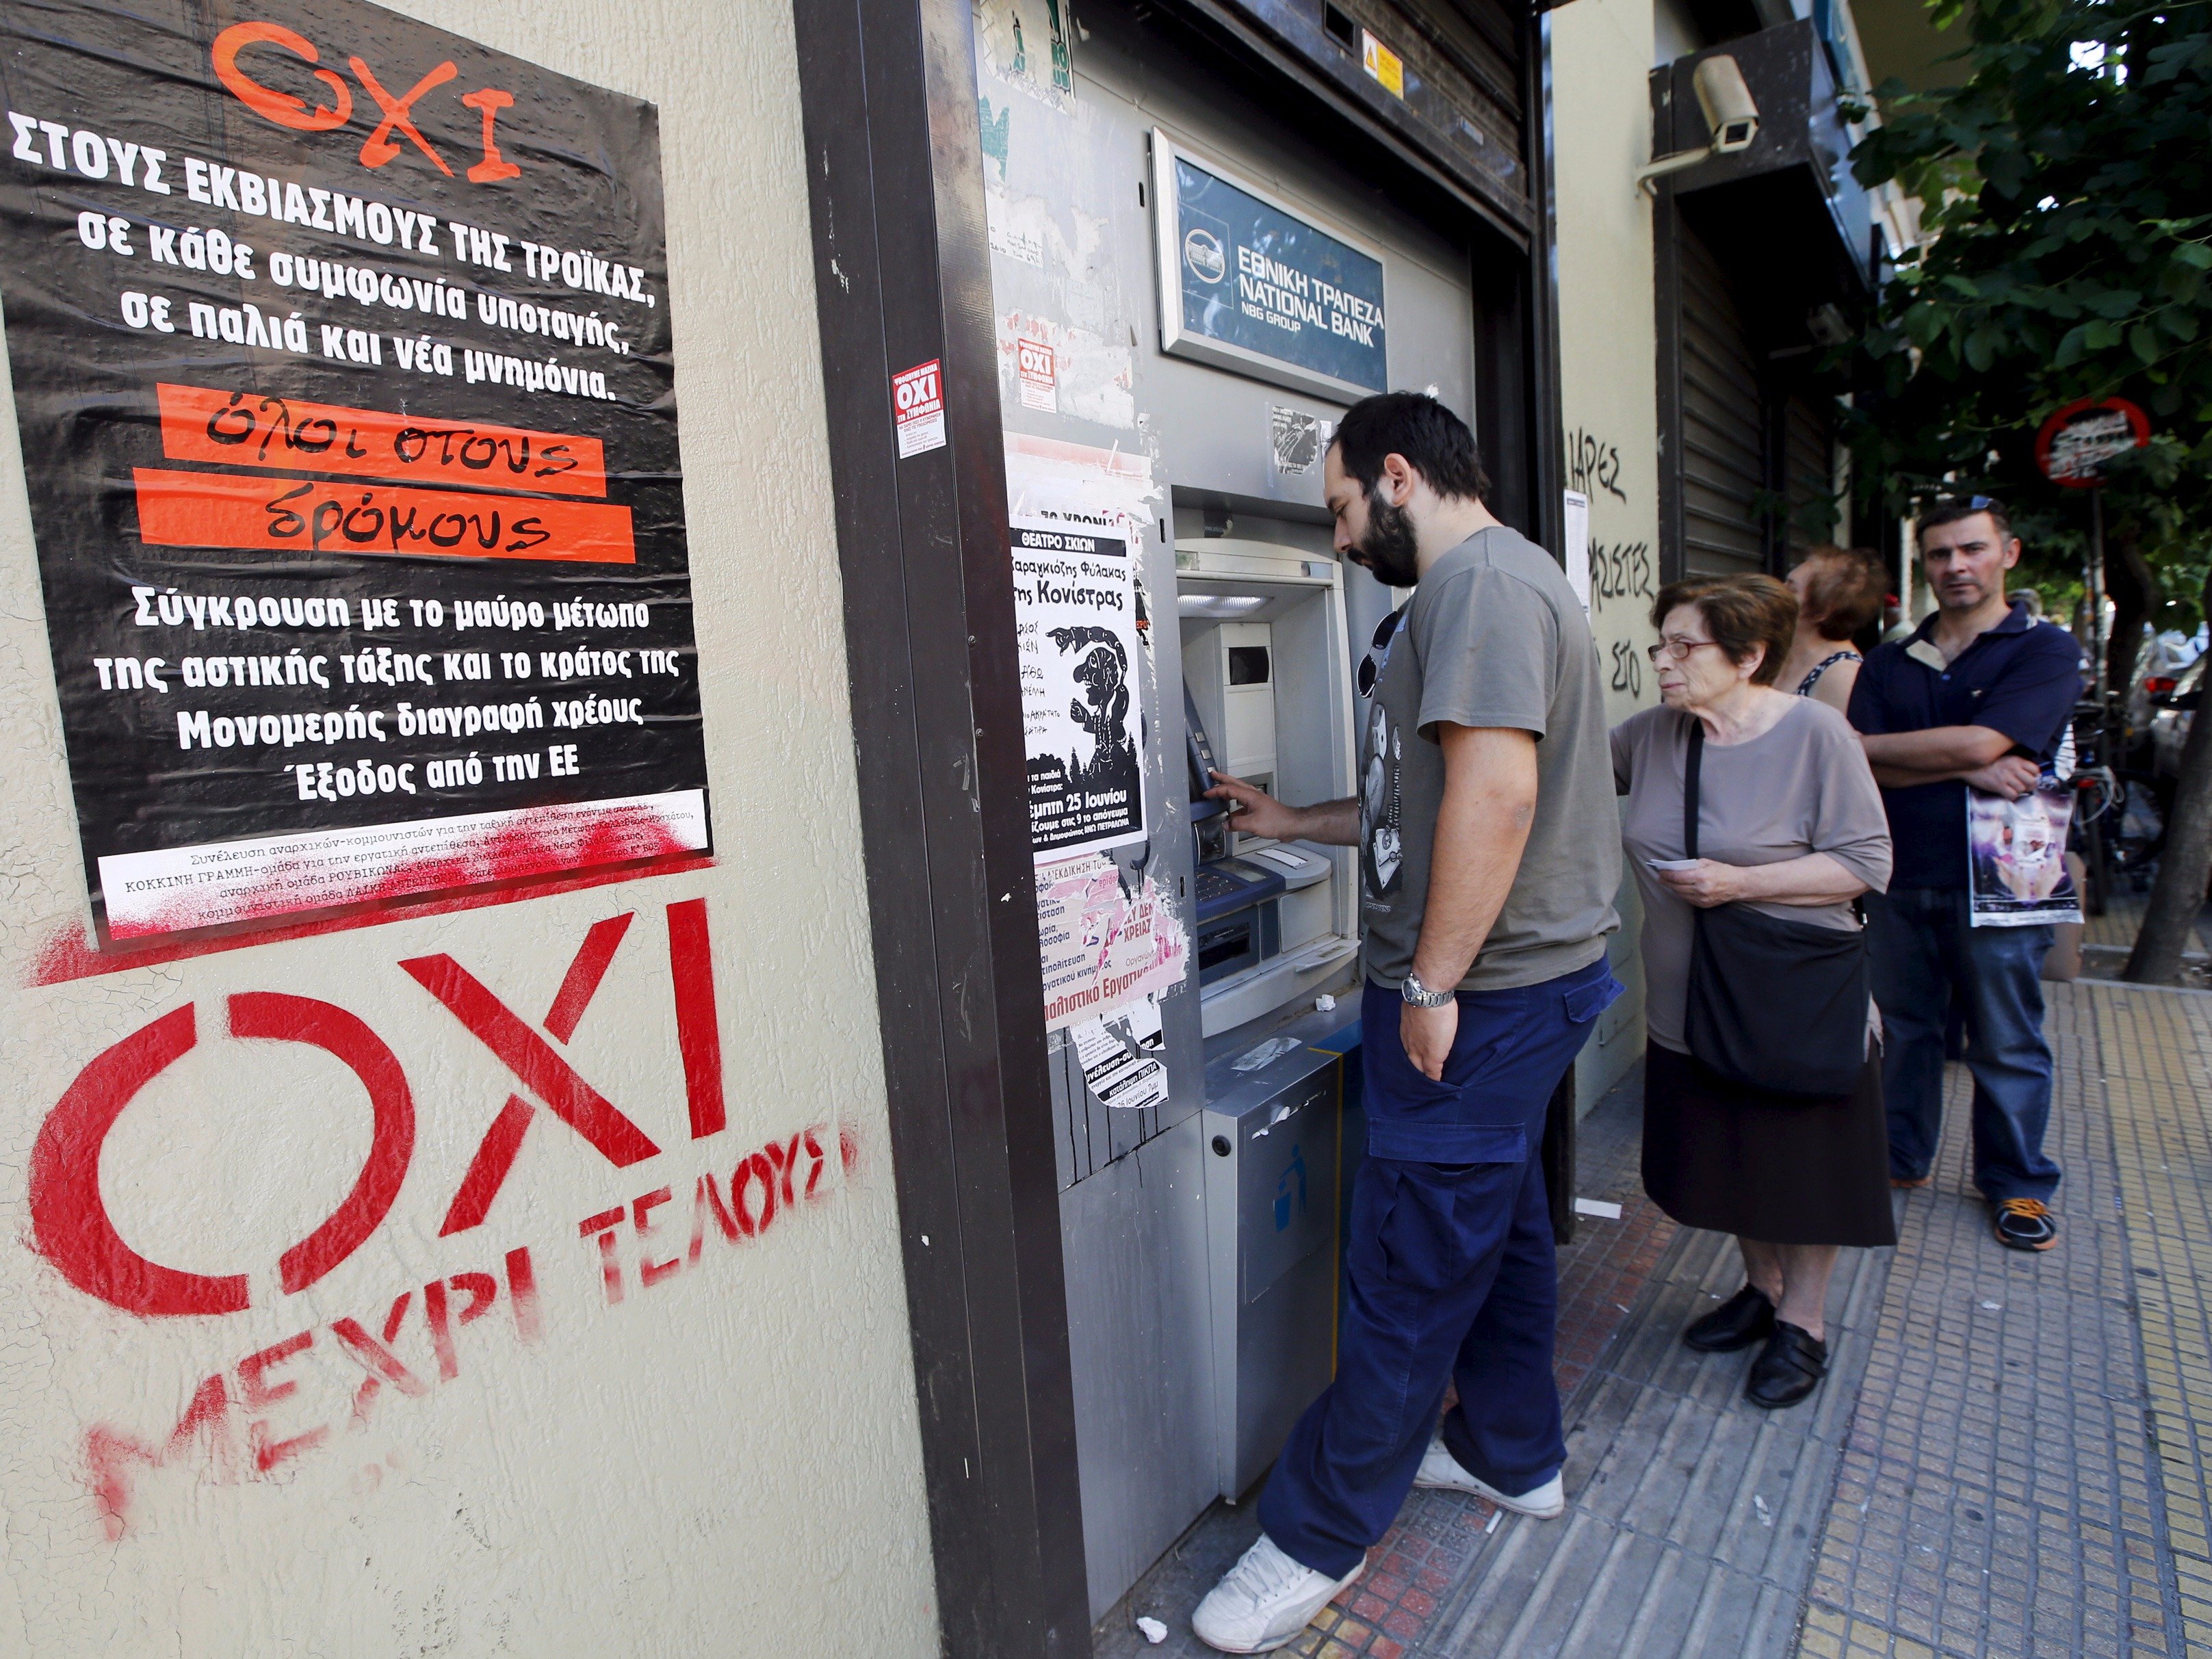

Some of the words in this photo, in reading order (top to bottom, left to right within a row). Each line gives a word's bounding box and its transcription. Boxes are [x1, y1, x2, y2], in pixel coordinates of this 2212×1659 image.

[212, 21, 521, 183] ΟΧΙ
[8, 112, 170, 196] ΣΤΟΥΣ
[185, 157, 438, 256] ΕΚΒΙΑΣΜΟΥΣ
[450, 222, 512, 272] ΤΗΣ
[521, 240, 655, 309] ΤΡΟΪΚΑΣ,
[79, 211, 133, 256] σε
[150, 226, 256, 280] κάθε
[270, 250, 466, 320] συμφωνία
[478, 291, 629, 355] υποταγής,
[1238, 245, 1308, 296] ΕΘΝΙΚΗ
[1312, 278, 1384, 329] ΤΡΑΠΕΖΑ
[1239, 273, 1328, 329] NATIONAL
[1331, 311, 1374, 348] BANK
[1241, 302, 1264, 320] NBG
[1266, 311, 1301, 333] GROUP
[121, 291, 174, 334] σε
[191, 300, 308, 354] παλιά
[322, 326, 381, 365] και
[394, 337, 452, 376] νέα
[465, 350, 616, 401] μνημόνια.
[1020, 348, 1052, 375] ΟΧΙ
[897, 374, 937, 410] ΟΧΙ
[906, 399, 941, 419] ΣΥΜΦΩΝΙΑ
[207, 394, 366, 458] όλοι
[395, 426, 578, 478] στους
[266, 483, 550, 552] δρόμους
[1022, 532, 1062, 549] ΘΕΑΤΡΟ
[1065, 536, 1095, 552] ΣΚΙΩΝ
[1081, 561, 1126, 582] Φύλακας
[131, 586, 349, 630] Σύγκρουση
[361, 597, 400, 631] με
[411, 598, 443, 627] το
[455, 596, 545, 631] μαύρο
[554, 599, 649, 630] μέτωπο
[1037, 580, 1123, 611] Κονίστρας
[94, 655, 165, 695] της
[182, 649, 330, 692] αστικής
[341, 647, 433, 690] τάξης
[443, 653, 491, 680] και
[499, 653, 531, 679] το
[539, 649, 632, 681] κράτος
[640, 648, 680, 678] της
[177, 708, 386, 749] Μονομερής
[398, 701, 544, 737] διαγραφή
[552, 695, 644, 732] χρέους
[284, 762, 415, 802] Έξοδος
[426, 759, 483, 794] από
[493, 749, 541, 781] την
[549, 744, 580, 776] ΕΕ
[1031, 783, 1063, 794] Κονίστρα:
[1040, 769, 1061, 781] παιδιά
[1061, 815, 1076, 827] στις
[1076, 813, 1082, 824] 9
[1083, 814, 1091, 822] το
[1093, 807, 1128, 821] απόγευμα
[1066, 792, 1082, 812] 25
[1085, 787, 1127, 809] Ιουνίου
[191, 848, 265, 865] Συνέλευση
[270, 826, 432, 857] αναρχικών-κομμουνιστών
[436, 826, 454, 837] για
[458, 824, 476, 834] την
[480, 817, 514, 831] ταξική
[1084, 824, 1096, 834] ΑΝΩ
[125, 874, 194, 893] ΚΟΚΚΙΝΗ
[198, 861, 299, 883] ΓΡΑΜΜΗ-ομάδα
[303, 859, 324, 871] για
[328, 855, 350, 866] την
[354, 846, 408, 863] εργατική
[220, 880, 283, 898] αναρχική
[287, 876, 325, 890] ομάδα
[554, 839, 575, 850] Νέας
[306, 890, 343, 903] ομάδα
[1138, 1062, 1157, 1080] ΠΙΚΠΑ
[29, 897, 726, 1318] ΟΧΙ
[1125, 1088, 1147, 1105] Ιουνίου
[83, 1245, 541, 1541] ΜΕΧΡΙ
